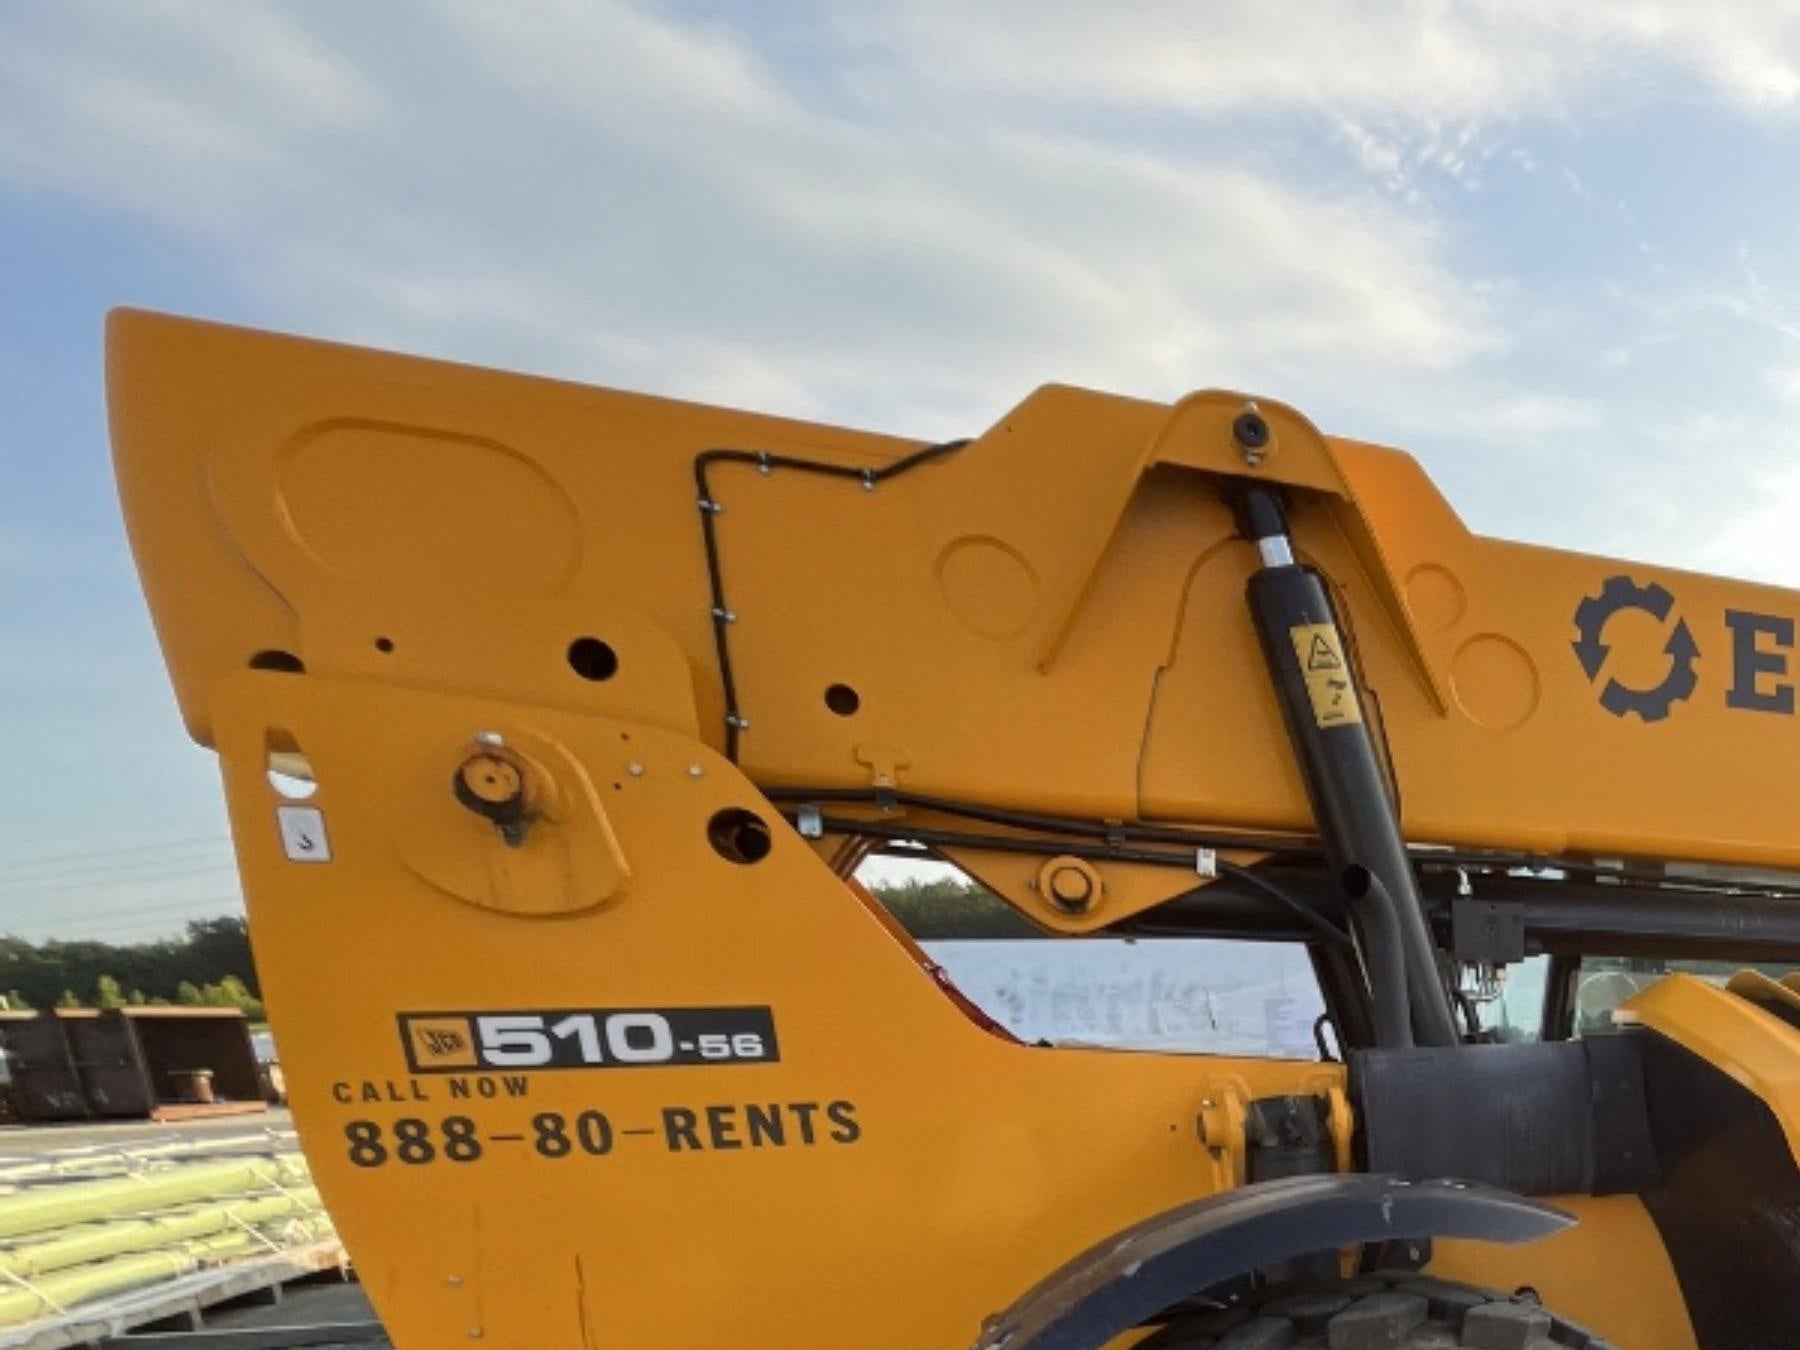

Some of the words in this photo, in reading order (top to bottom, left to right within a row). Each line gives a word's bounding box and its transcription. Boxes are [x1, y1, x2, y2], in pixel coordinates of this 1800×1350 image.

[476, 1012, 765, 1067] 510-56
[332, 1078, 430, 1104] CALL
[450, 1075, 530, 1100] NOW
[346, 1099, 861, 1169] 888-80-RENTS
